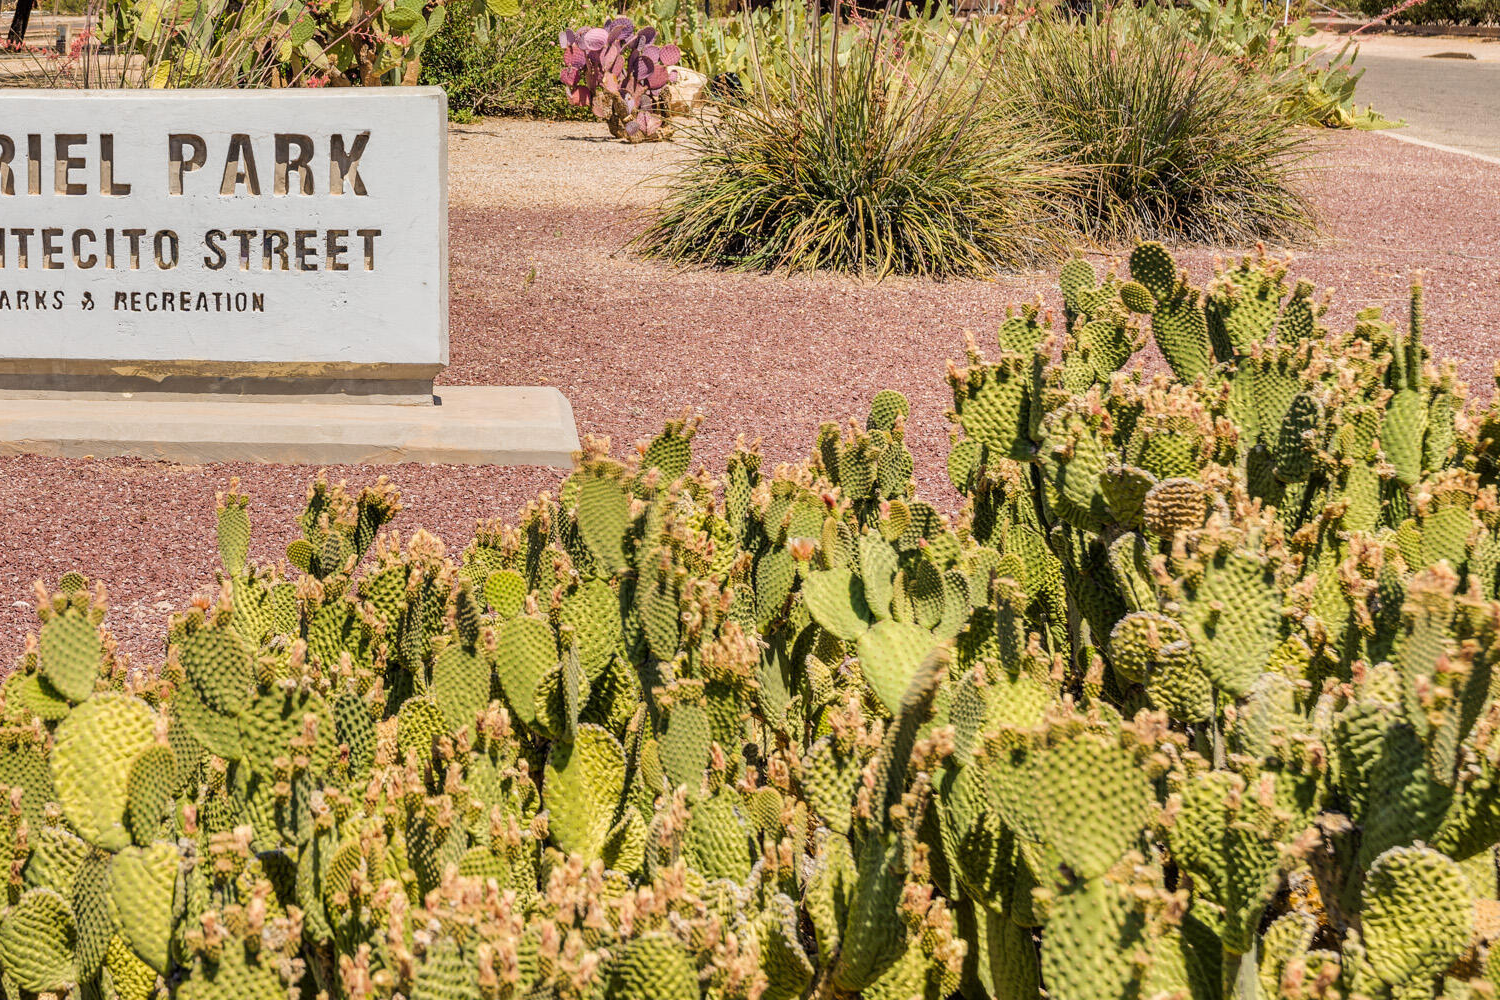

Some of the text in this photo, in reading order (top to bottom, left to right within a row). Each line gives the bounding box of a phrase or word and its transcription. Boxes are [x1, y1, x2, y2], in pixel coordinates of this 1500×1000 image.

[168, 131, 372, 197] PARK
[203, 228, 382, 272] STREET
[80, 291, 95, 311] &
[114, 290, 266, 313] RECREATION
